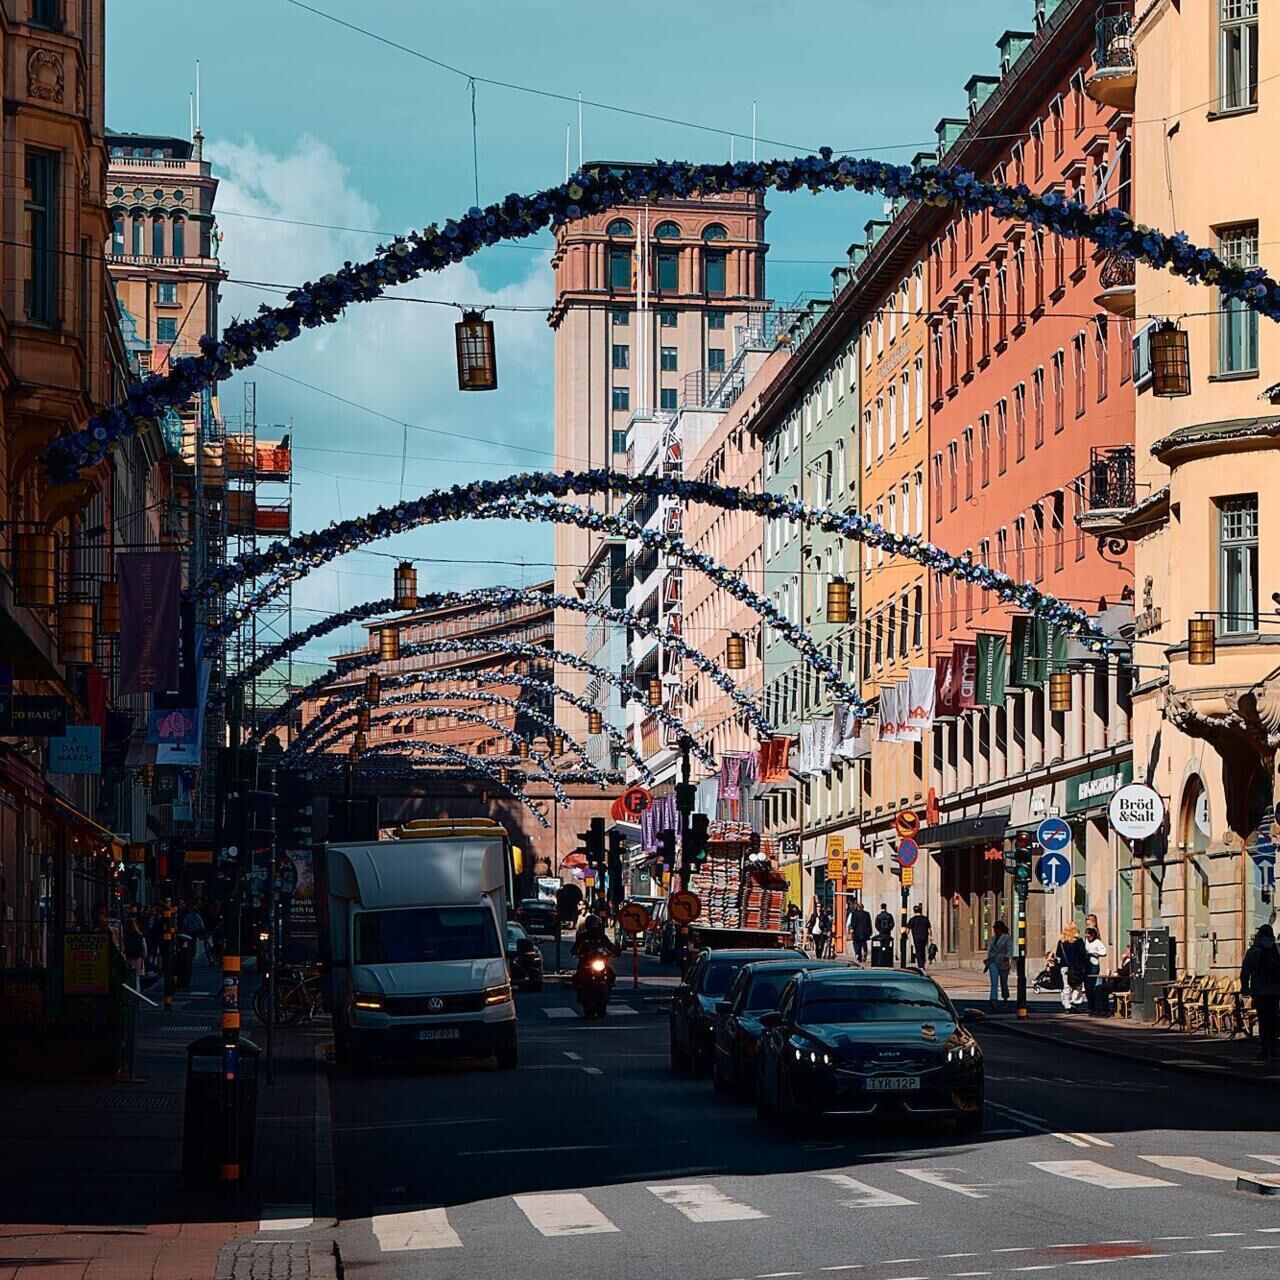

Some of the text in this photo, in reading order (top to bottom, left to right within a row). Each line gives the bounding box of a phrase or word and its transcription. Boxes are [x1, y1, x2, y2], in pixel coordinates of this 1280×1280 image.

[1022, 624, 1031, 681] NATURKOMANIET
[985, 642, 995, 701] NATURKOMPANIET
[909, 705, 930, 720] MAX
[819, 725, 827, 752] balance
[62, 745, 89, 753] DAY'S
[1119, 798, 1154, 810] Bröd
[1119, 810, 1155, 822] &Salt
[871, 1078, 916, 1089] TYR 12P
